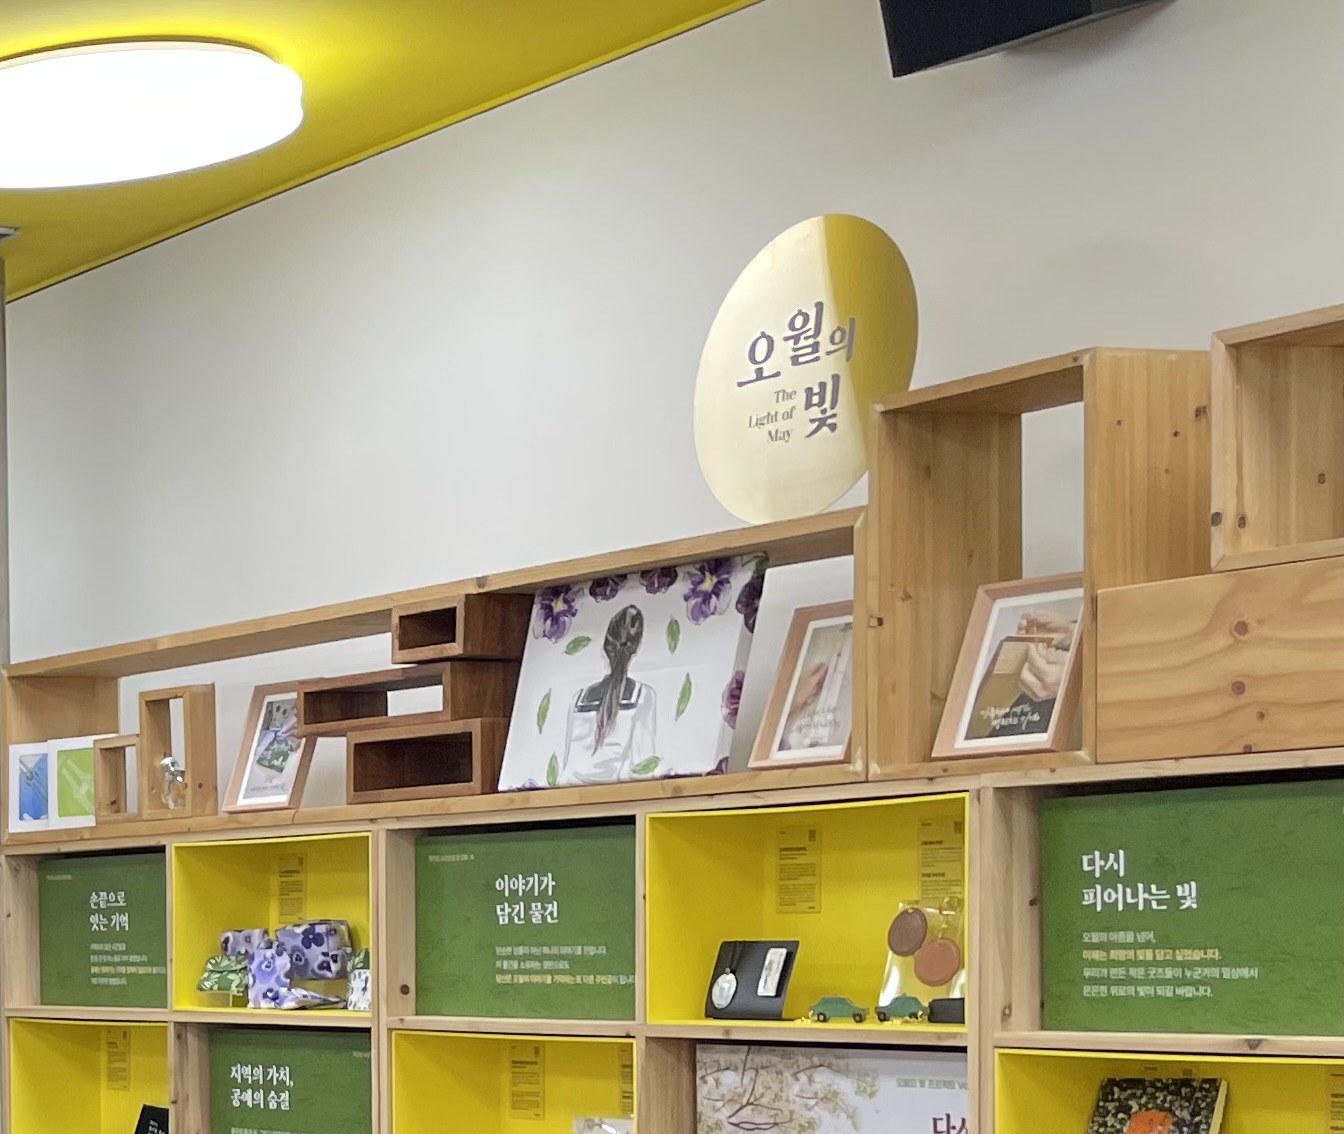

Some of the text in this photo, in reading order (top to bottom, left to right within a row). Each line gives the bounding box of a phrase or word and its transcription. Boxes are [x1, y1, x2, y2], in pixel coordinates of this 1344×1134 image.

[737, 301, 856, 388] 오월의
[774, 388, 797, 404] The
[804, 374, 841, 439] 빛
[748, 406, 796, 429] Light of
[767, 428, 793, 443] May
[1081, 849, 1125, 878] 다시
[495, 872, 556, 897] 이야기가
[1081, 881, 1198, 912] 피어나는 빛
[89, 912, 129, 931] 잇는 기억
[495, 900, 559, 925] 담긴 물건
[230, 1063, 294, 1087] 지역의 가치,
[230, 1088, 290, 1111] 공예의 숨결
